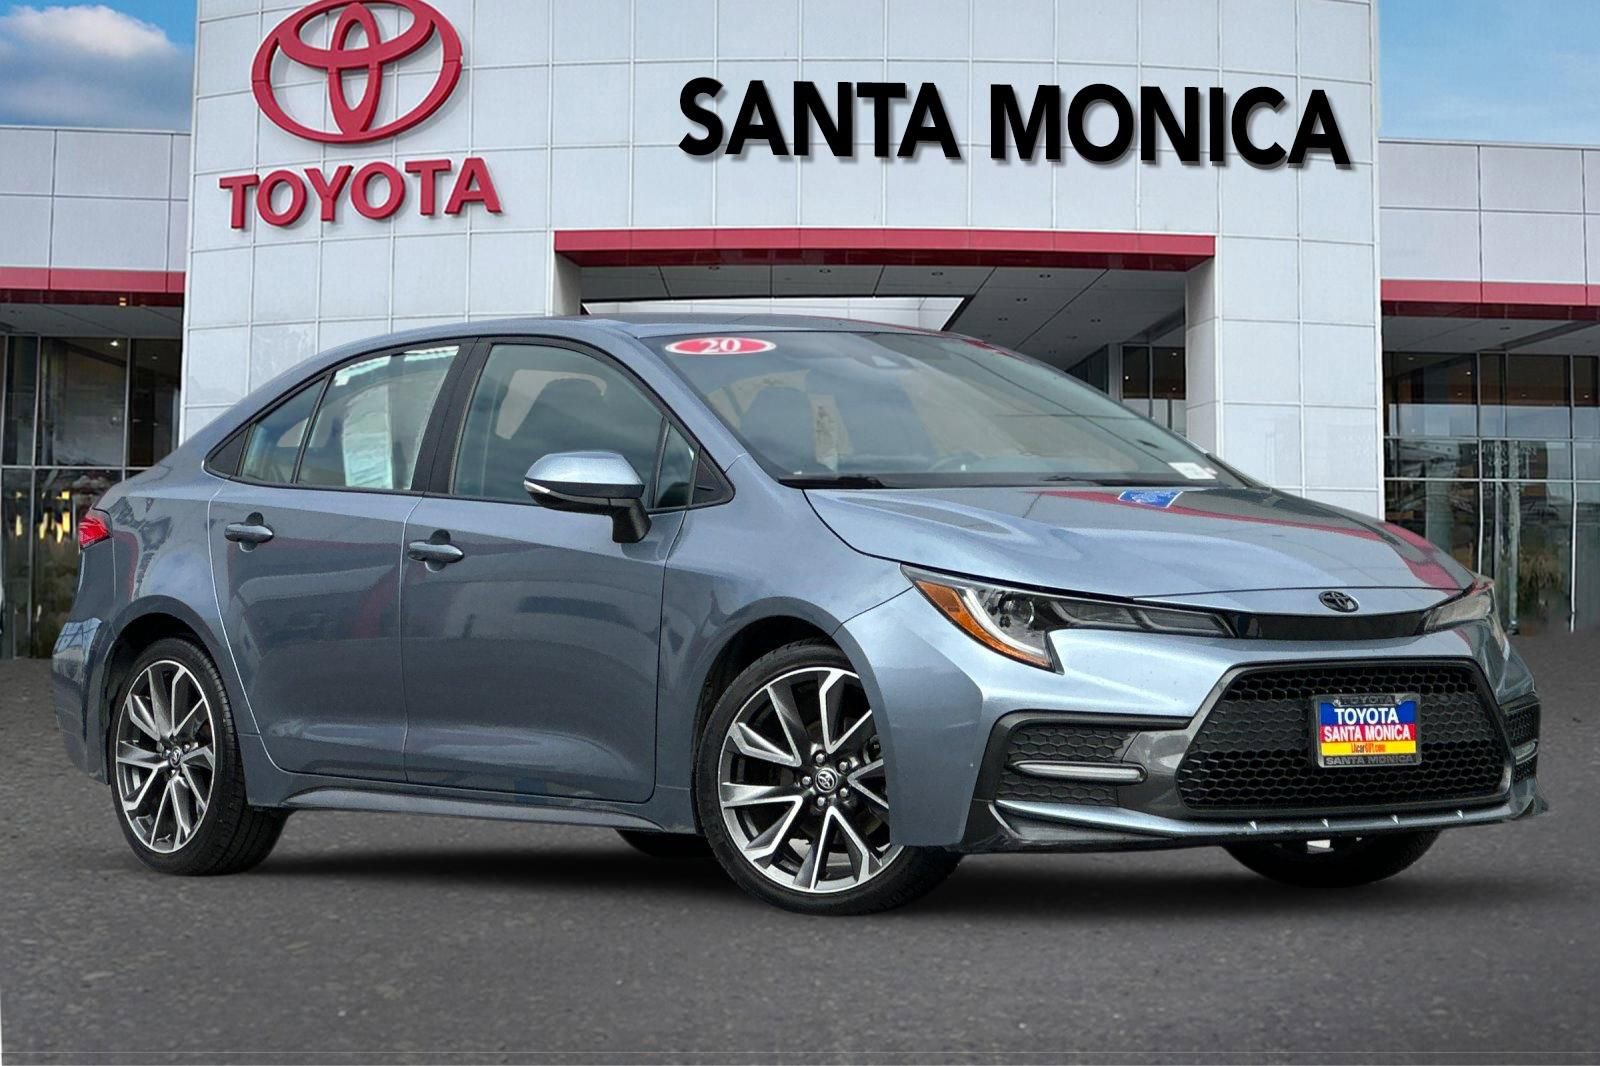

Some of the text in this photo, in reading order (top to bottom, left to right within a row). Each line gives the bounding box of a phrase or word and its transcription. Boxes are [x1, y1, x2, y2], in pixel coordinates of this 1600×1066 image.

[679, 77, 1352, 168] SANTA MONICA
[219, 157, 502, 229] TOYOTA
[699, 338, 741, 354] 20
[1341, 695, 1396, 705] TOYOTA
[1334, 707, 1400, 725] TOYOTA
[1324, 724, 1411, 742] SANTA MONICA
[1325, 755, 1414, 766] SANTA MONICA
